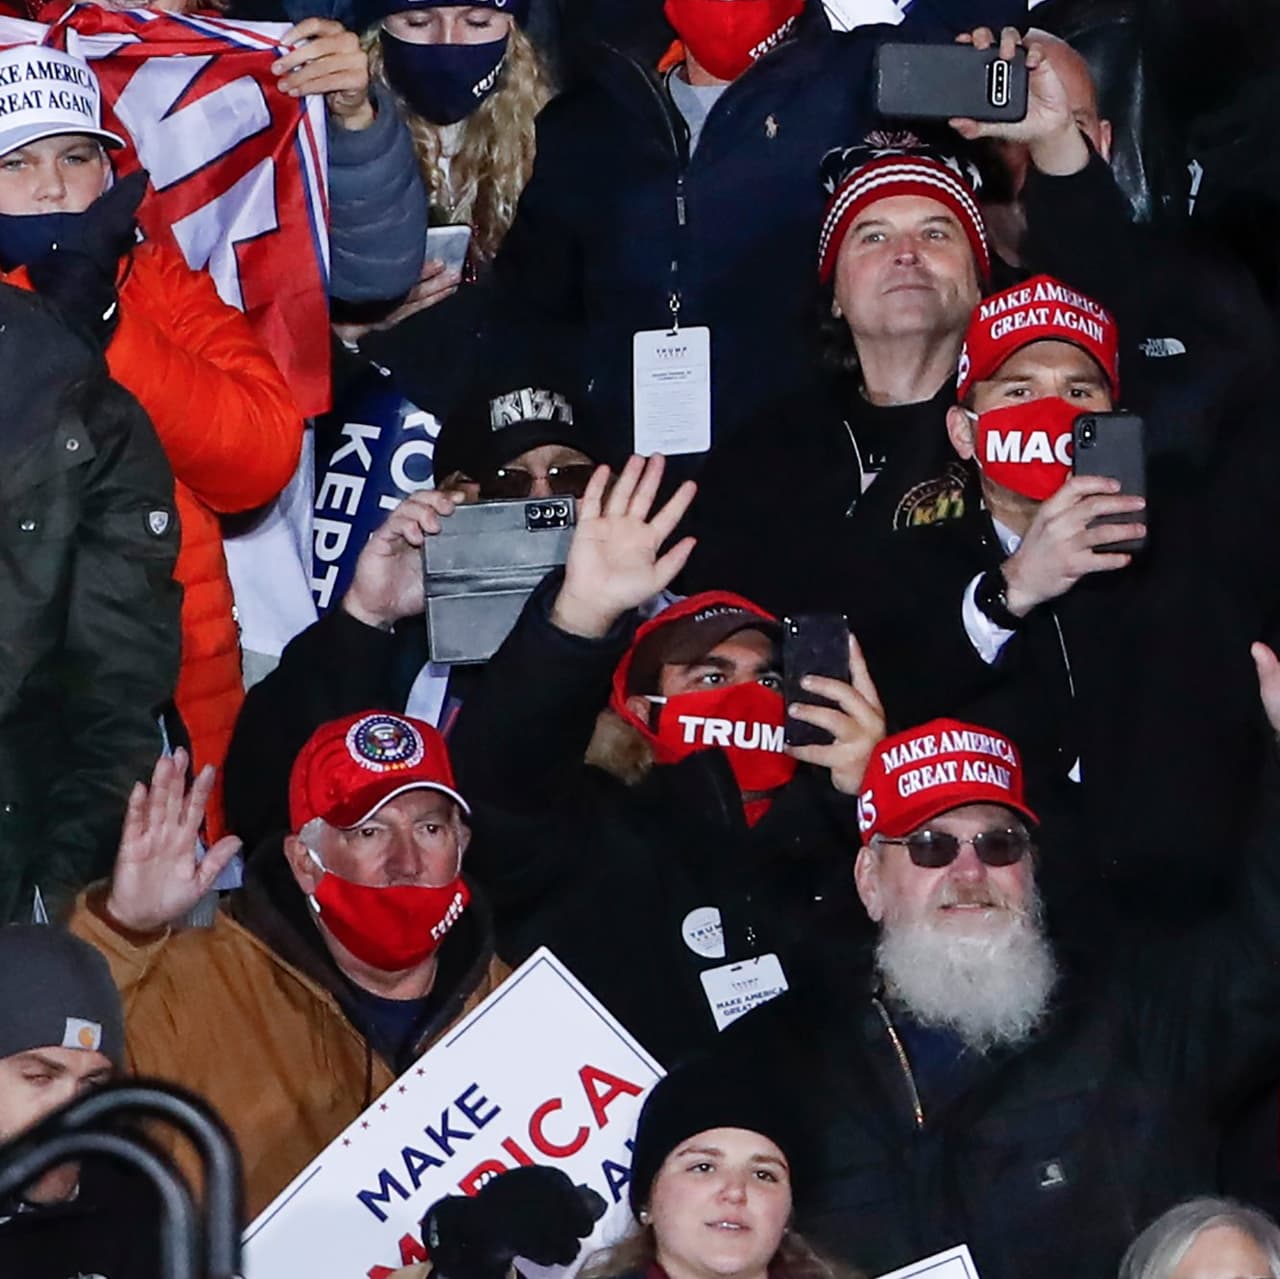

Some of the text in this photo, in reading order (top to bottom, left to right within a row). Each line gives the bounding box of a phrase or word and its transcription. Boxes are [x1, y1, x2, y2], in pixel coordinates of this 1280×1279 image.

[25, 61, 96, 93] AMERICA
[48, 91, 94, 118] AGAIN
[979, 284, 1109, 323] MAKE AMERICA
[990, 307, 1105, 345] GREAT AGAIN
[308, 421, 382, 608] KEPT
[677, 715, 786, 754] TRUM
[880, 728, 1017, 775] MAKE AMERICA
[897, 757, 1012, 798] GREAT AGAIN
[716, 987, 786, 1009] MAKE AMERICA
[723, 1002, 753, 1017] GREAT
[356, 1082, 503, 1223] MAKE
